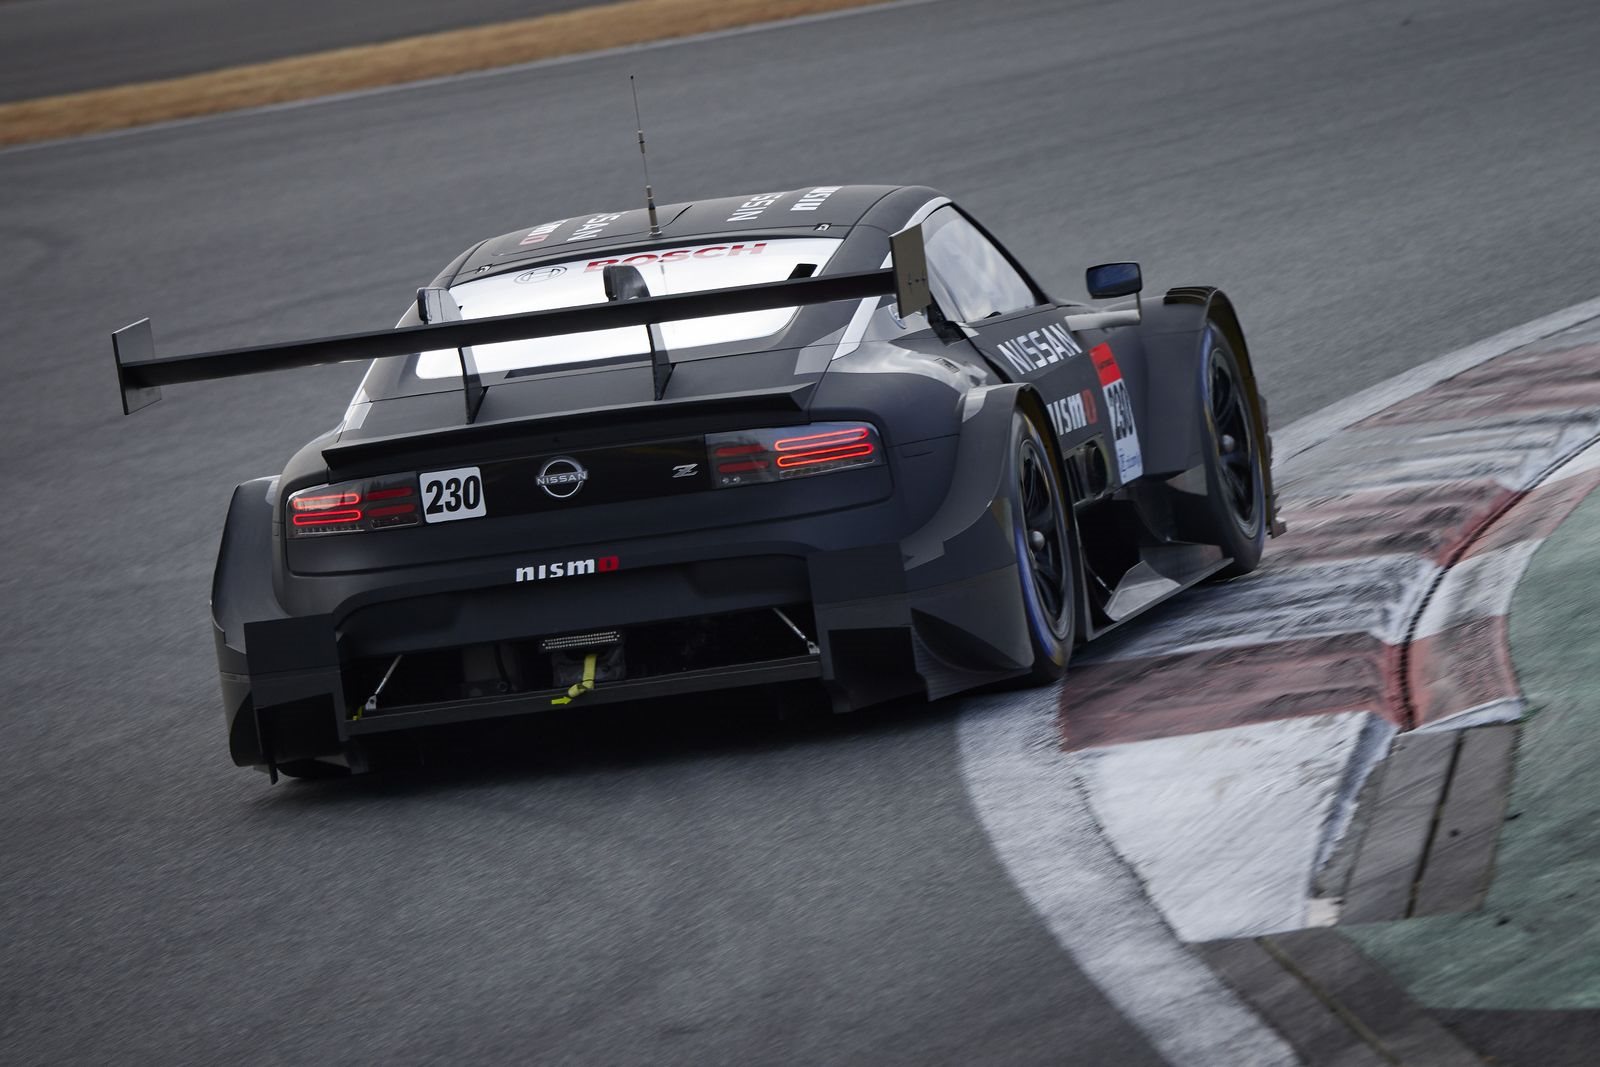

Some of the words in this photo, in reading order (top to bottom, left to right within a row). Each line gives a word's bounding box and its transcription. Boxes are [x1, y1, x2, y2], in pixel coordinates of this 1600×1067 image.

[583, 243, 768, 273] BOSCH
[997, 323, 1083, 375] NISSAN
[536, 470, 588, 486] NISSAN
[425, 474, 481, 515] 230
[515, 555, 620, 582] nismo
